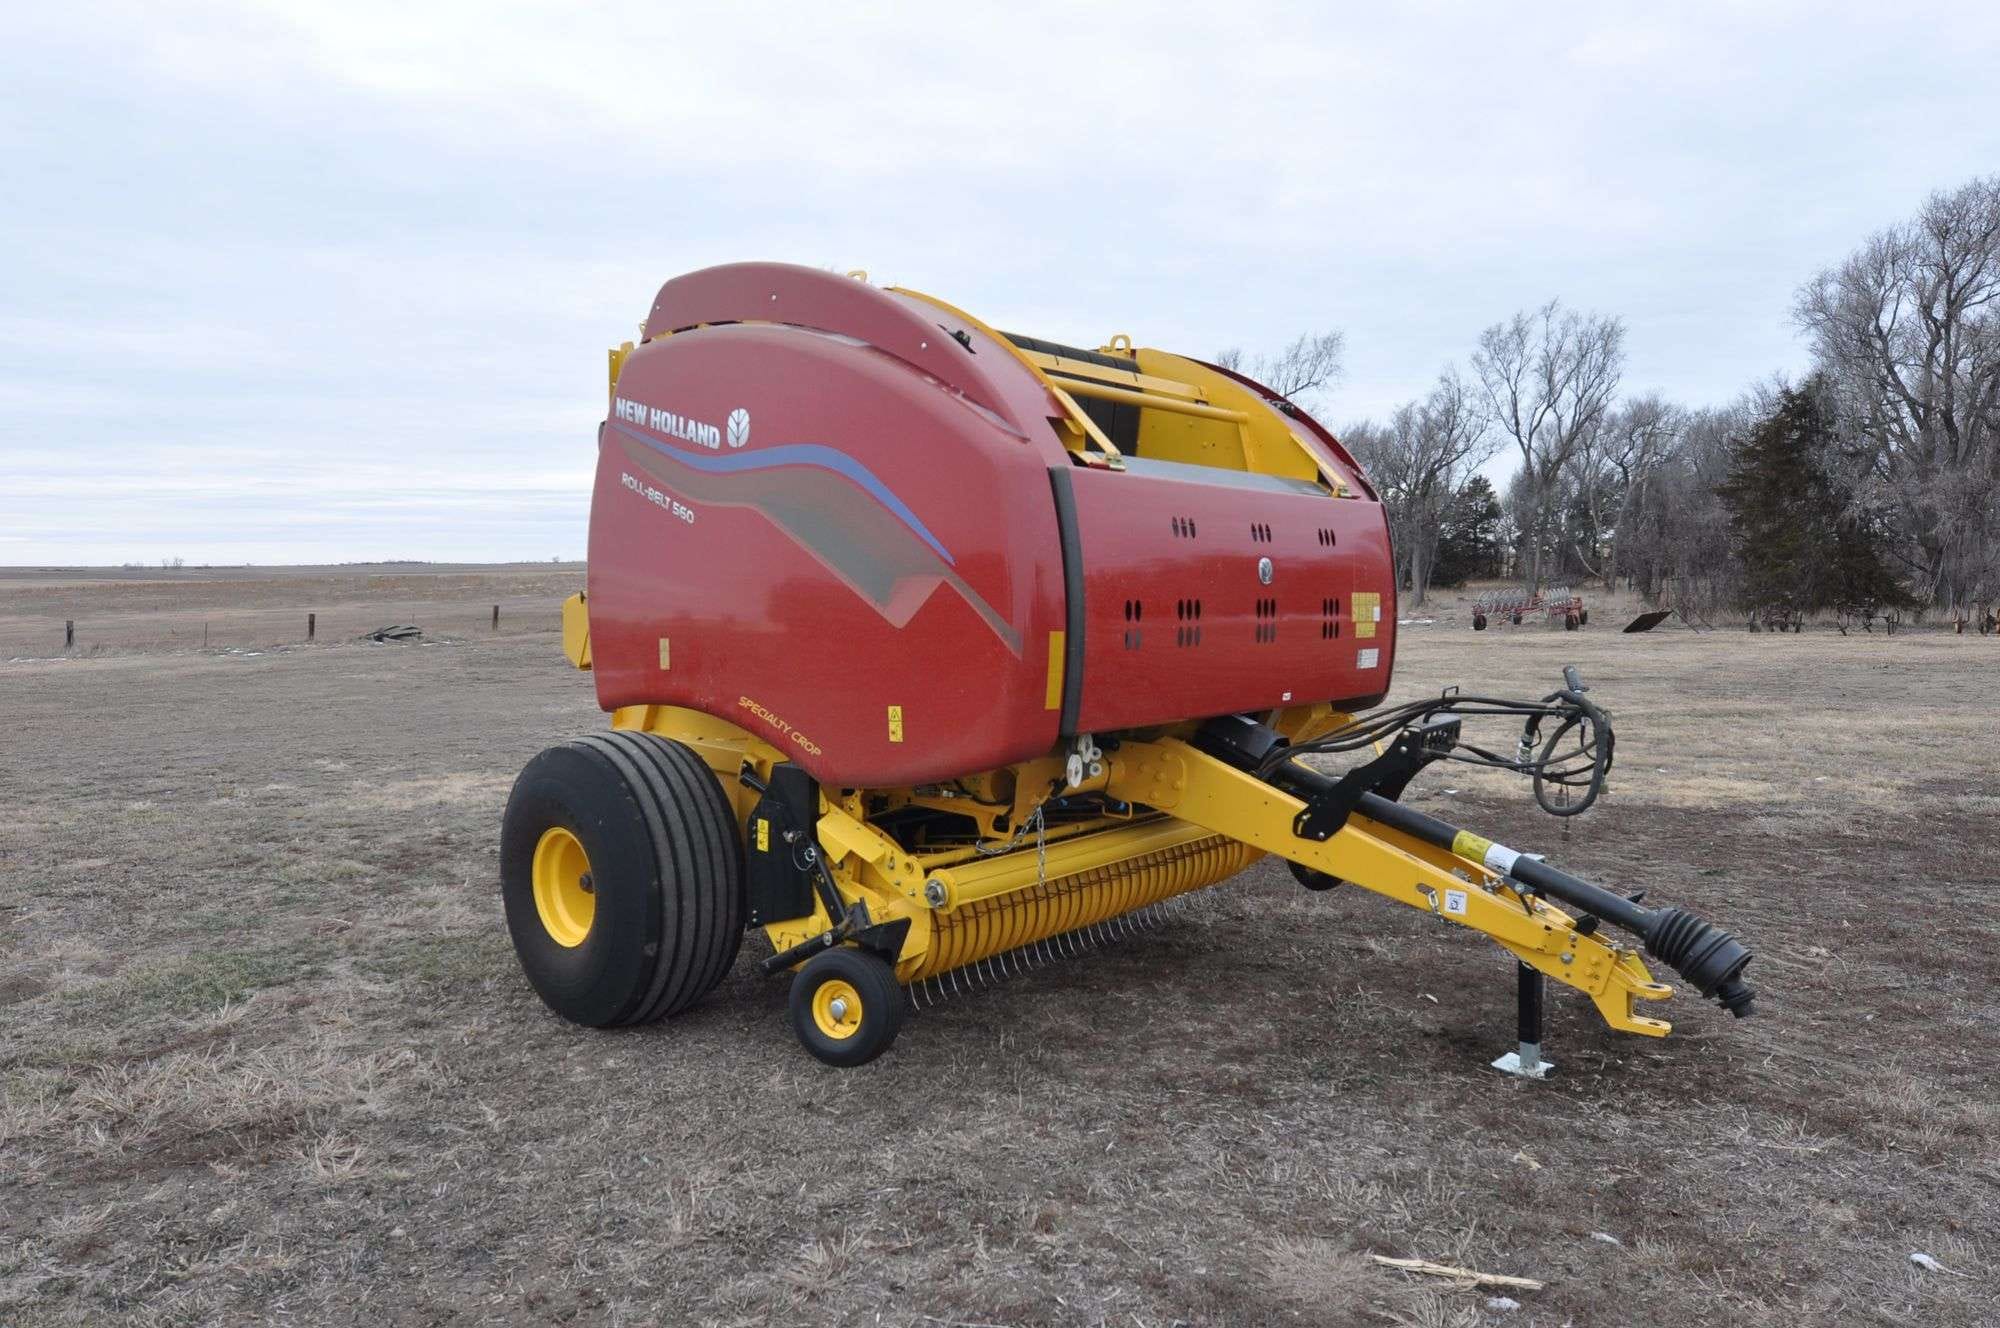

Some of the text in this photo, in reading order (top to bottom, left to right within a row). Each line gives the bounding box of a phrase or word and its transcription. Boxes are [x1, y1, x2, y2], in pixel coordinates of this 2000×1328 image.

[616, 397, 720, 449] NEW HOLLAND
[621, 472, 695, 524] ROLL-BELT 560
[738, 695, 822, 756] SPECIALTY CROP
